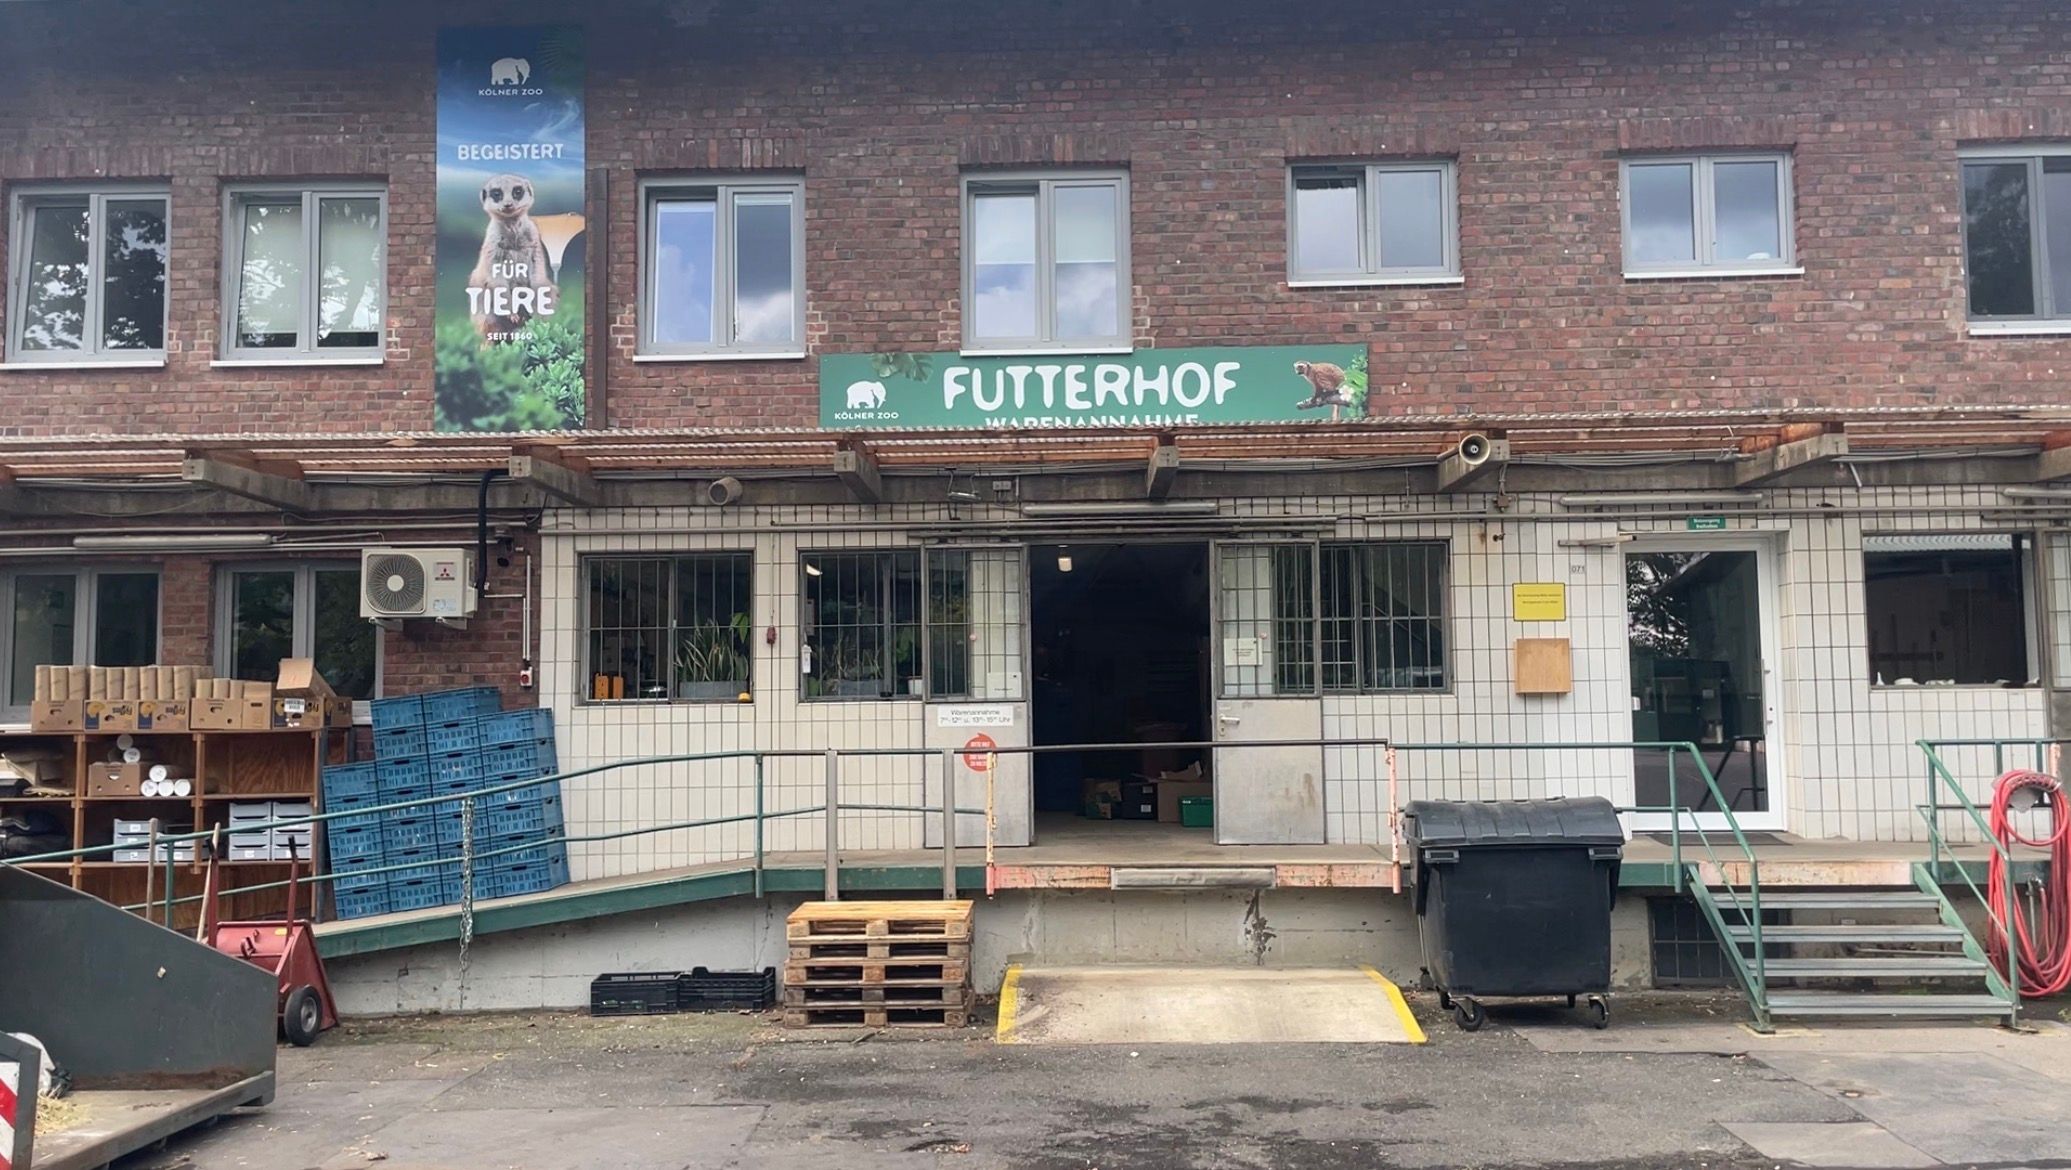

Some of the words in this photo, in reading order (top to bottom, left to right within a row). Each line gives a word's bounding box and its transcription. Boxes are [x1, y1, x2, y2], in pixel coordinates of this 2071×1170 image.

[478, 87, 518, 96] KÖLNER
[457, 143, 564, 161] BEGEISTERT
[492, 259, 529, 279] FÜR
[465, 286, 555, 316] TIERE
[487, 332, 508, 341] SEIT
[510, 332, 534, 341] 1860
[943, 361, 1241, 412] FUTTERHOF
[834, 411, 875, 420] KÖLNER
[877, 411, 900, 420] ZOO
